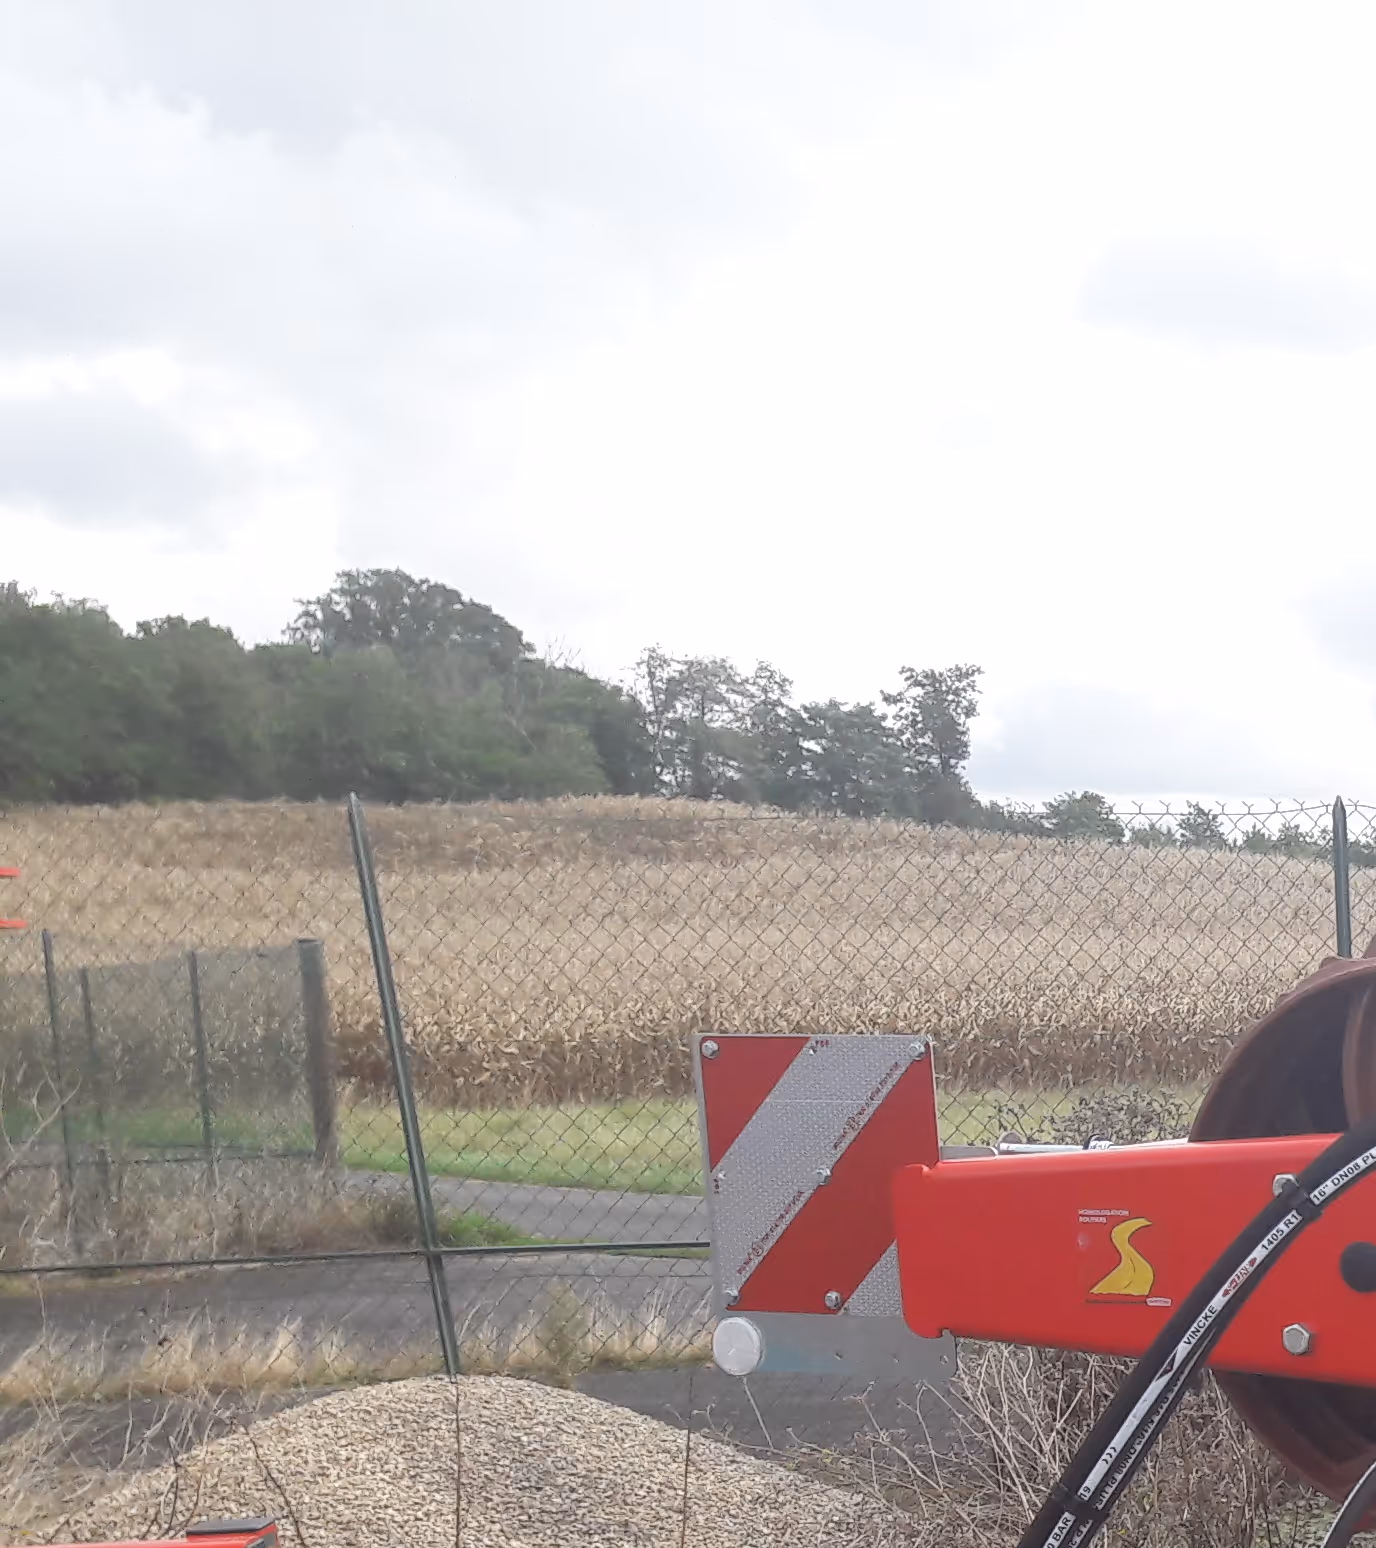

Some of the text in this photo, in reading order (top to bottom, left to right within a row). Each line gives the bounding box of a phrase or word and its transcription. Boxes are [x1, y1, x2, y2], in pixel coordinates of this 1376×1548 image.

[1183, 1304, 1219, 1346] VINCKE
[1260, 1227, 1286, 1252] 1405
[1283, 1212, 1301, 1230] R1
[1331, 1162, 1362, 1187] DN08
[1052, 1516, 1072, 1542] BAR
